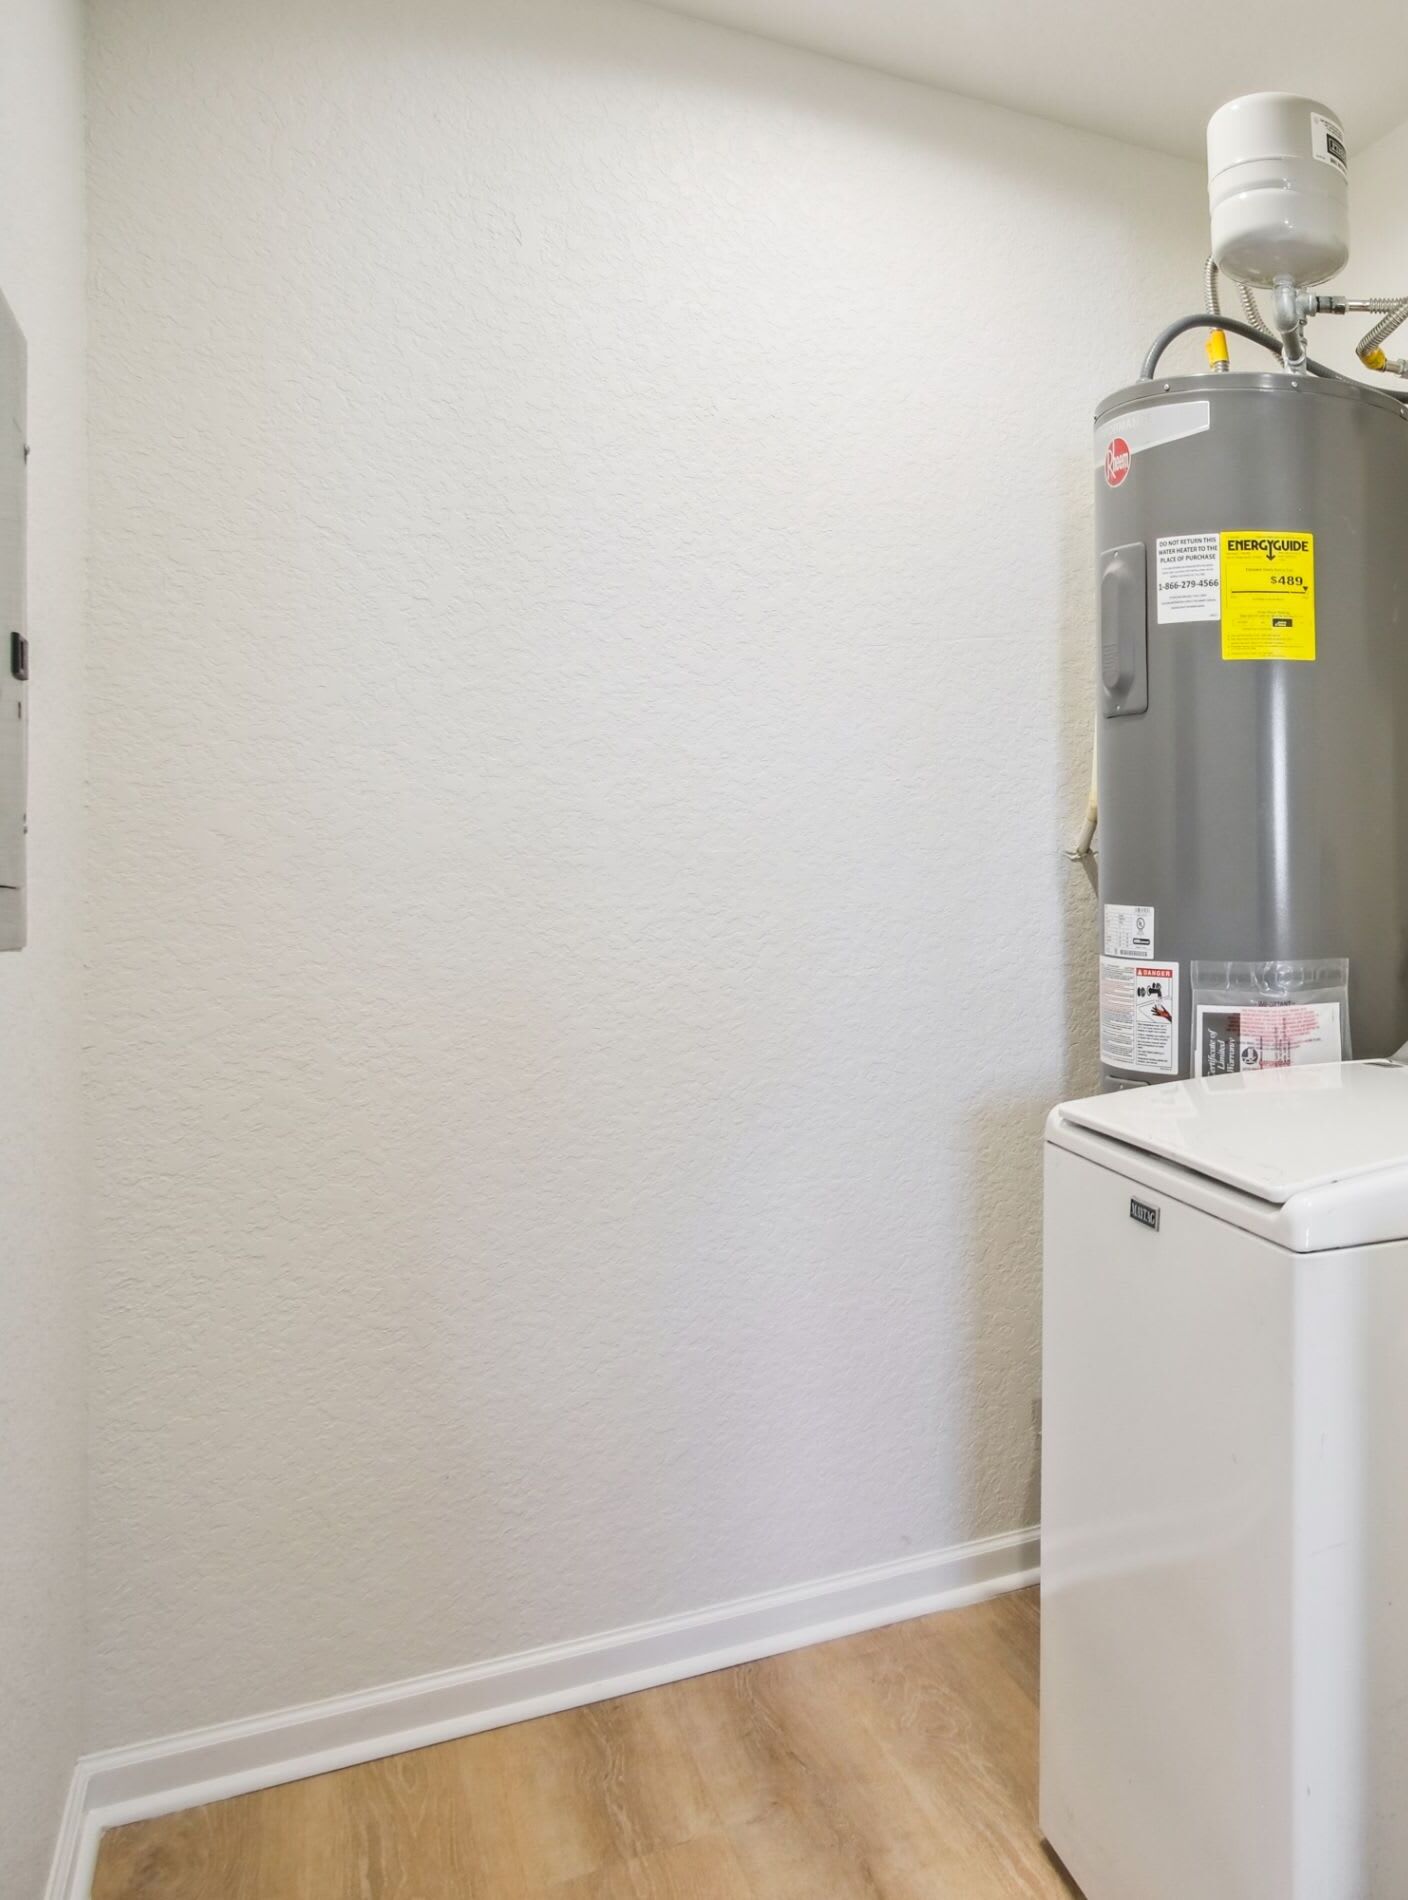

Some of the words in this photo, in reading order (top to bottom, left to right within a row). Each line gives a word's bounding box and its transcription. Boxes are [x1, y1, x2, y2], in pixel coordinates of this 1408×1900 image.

[1106, 439, 1130, 481] Rheem
[1228, 539, 1309, 552] ENERGYGUIDE
[1159, 548, 1175, 556] WATER
[1185, 553, 1216, 561] PURCHASE
[1159, 579, 1219, 590] 1-866-279-4566
[1270, 576, 1303, 586] $489
[1143, 969, 1171, 977] DANGER
